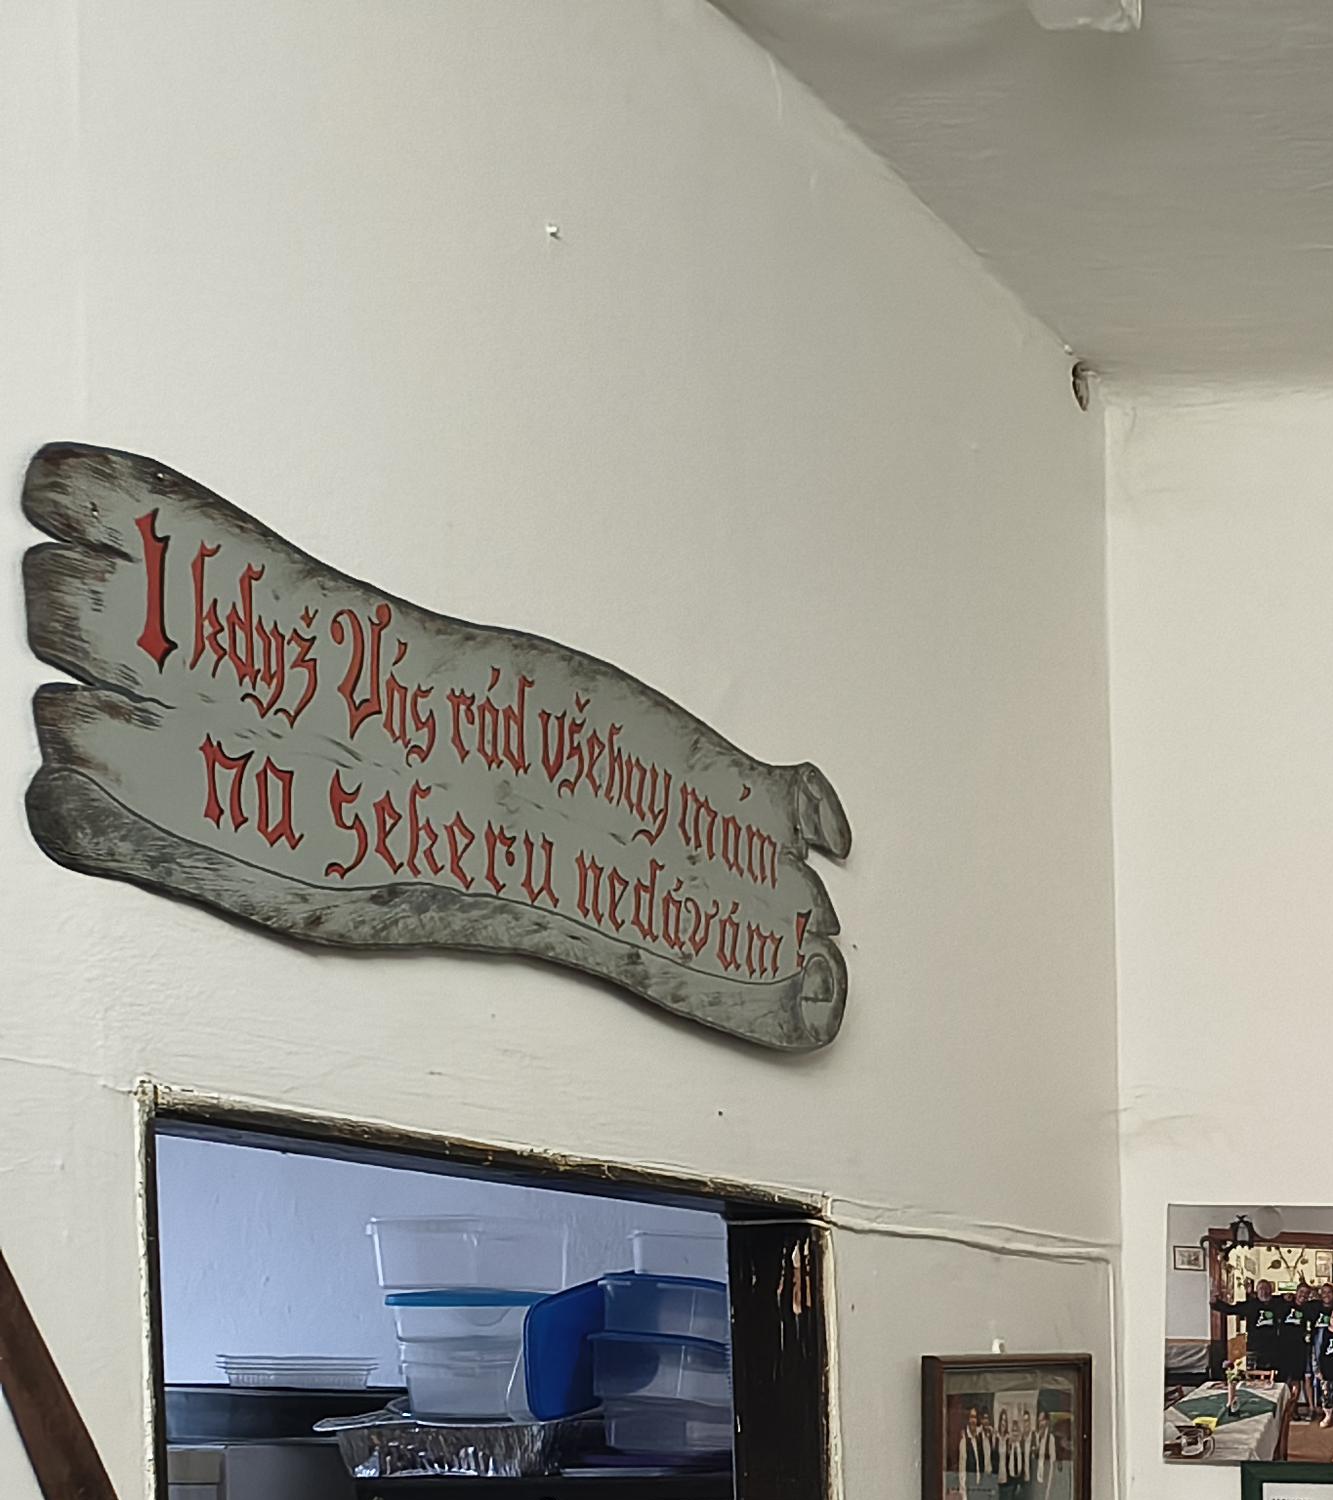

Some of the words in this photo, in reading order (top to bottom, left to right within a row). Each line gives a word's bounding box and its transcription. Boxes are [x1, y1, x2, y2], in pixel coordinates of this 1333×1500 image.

[134, 508, 178, 674] I
[190, 540, 318, 730] když
[331, 602, 436, 768] Vás
[446, 665, 535, 777] rád
[678, 782, 779, 890] mám
[199, 733, 304, 850] na
